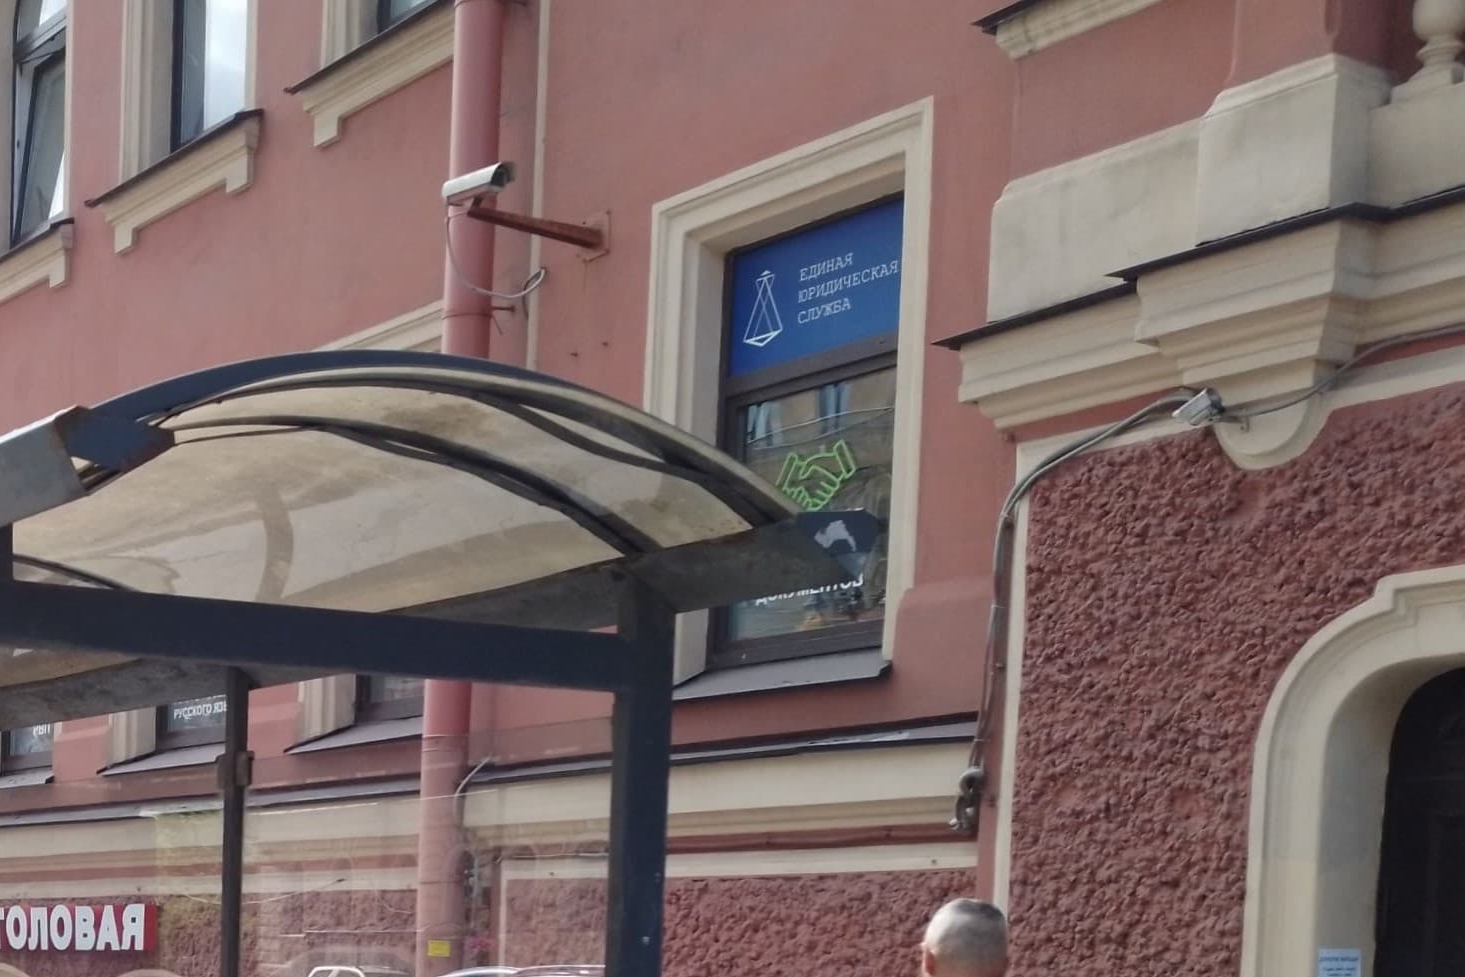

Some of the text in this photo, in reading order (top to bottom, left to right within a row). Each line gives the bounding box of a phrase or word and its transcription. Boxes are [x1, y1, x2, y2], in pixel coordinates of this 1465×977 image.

[799, 252, 854, 281] ЕДИНАЯ
[798, 260, 898, 303] ЮРИДИЧЕСКАЯ
[797, 297, 851, 324] СЛУЖБА
